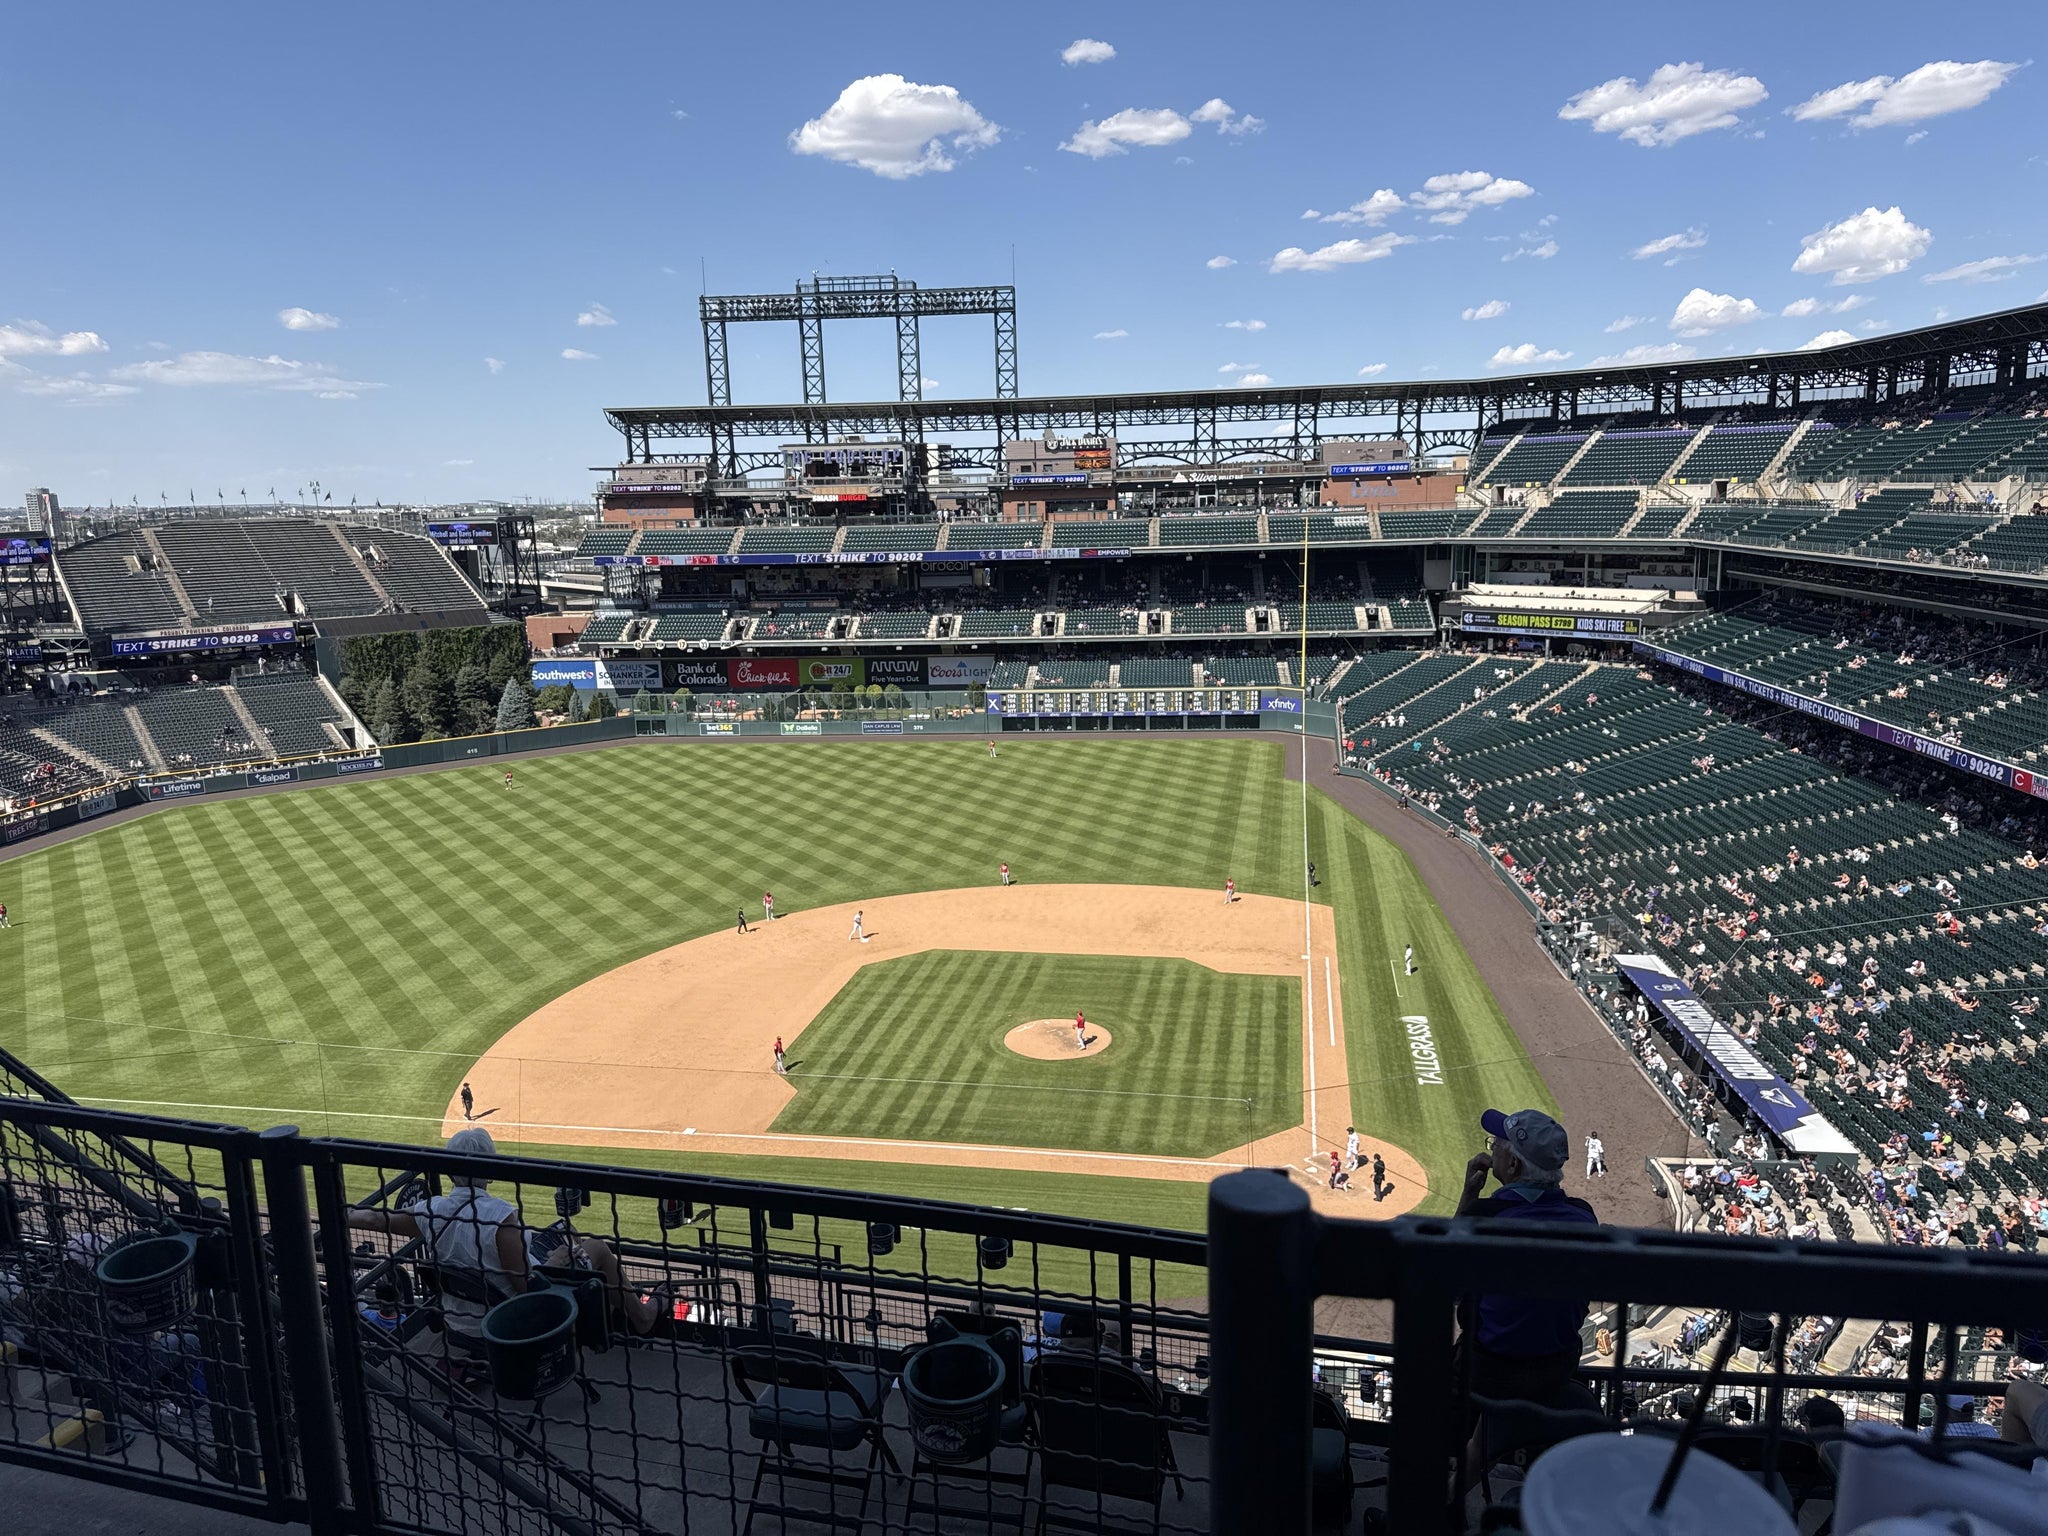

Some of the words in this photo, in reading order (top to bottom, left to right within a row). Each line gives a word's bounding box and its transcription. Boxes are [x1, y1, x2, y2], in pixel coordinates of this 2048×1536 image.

[1189, 473, 1217, 482] Silver
[795, 554, 820, 563] TEXT
[822, 554, 869, 562] 'STRIKE'
[872, 553, 885, 561] TO
[921, 560, 968, 571] birdcall
[1498, 614, 1528, 627] SEASON
[1530, 616, 1550, 628] PASS
[1554, 618, 1572, 627] $799
[1577, 618, 1594, 630] KIDS
[1595, 619, 1606, 631] SKI
[1608, 620, 1624, 632] FREE
[116, 641, 146, 652] TEXT
[148, 638, 200, 650] 'STRIKE'
[204, 637, 218, 646] TO
[222, 634, 258, 644] 90202
[678, 663, 703, 674] Bank
[705, 662, 717, 672] of
[834, 664, 852, 676] 24/7
[871, 661, 919, 672] ARROW
[930, 666, 963, 678] Coors
[532, 670, 587, 681] Southwest
[678, 673, 727, 685] Colorado
[1268, 698, 1295, 710] xfinity
[1722, 672, 1734, 684] WIN
[1749, 680, 1774, 700] TICKETS
[1780, 692, 1798, 708] FREE
[1798, 699, 1823, 716] BRECK
[1824, 707, 1860, 730] LODGING
[1891, 730, 1912, 748] TEXT
[1914, 737, 1953, 761] 'STRIKE'
[1956, 751, 1967, 767] TO
[1970, 758, 2004, 780] 90202
[259, 772, 290, 782] dialpad
[163, 782, 201, 793] Lifetime
[8, 825, 26, 838] TREE
[25, 819, 38, 829] TOP
[1406, 1024, 1444, 1085] TALLGRASS
[1694, 1033, 1775, 1081] COLORADO
[857, 1350, 874, 1365] 10
[1169, 1396, 1180, 1413] 8
[1514, 1448, 1527, 1466] 6
